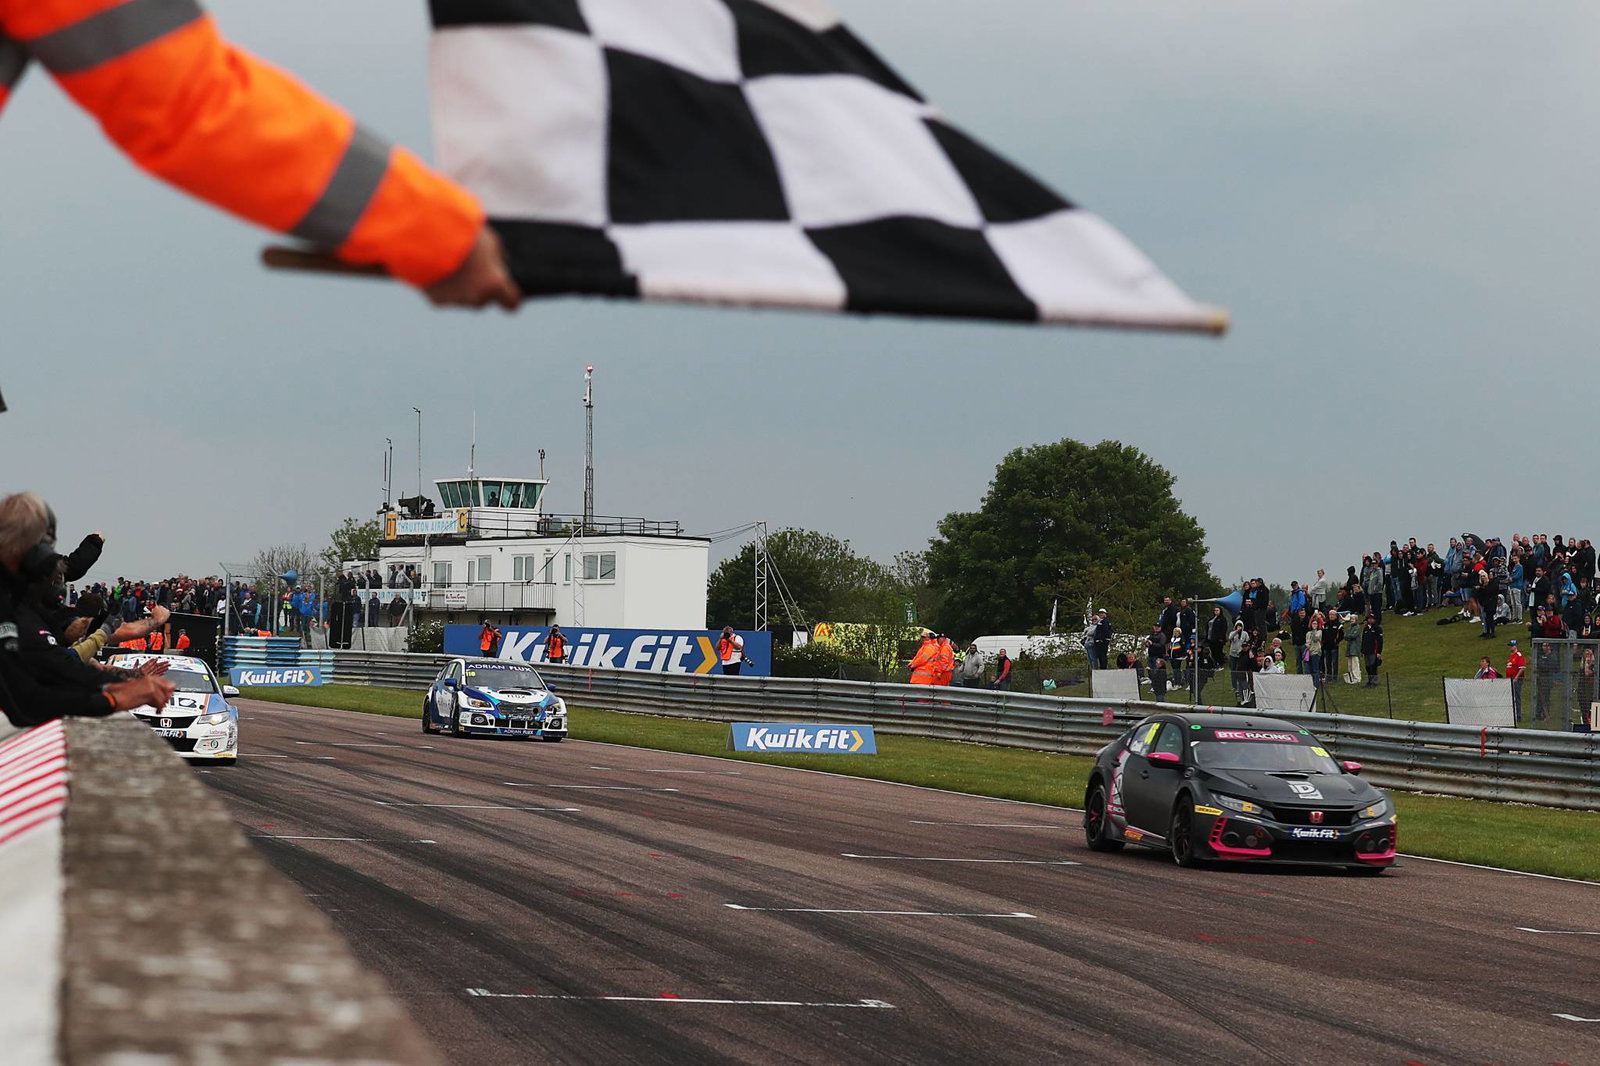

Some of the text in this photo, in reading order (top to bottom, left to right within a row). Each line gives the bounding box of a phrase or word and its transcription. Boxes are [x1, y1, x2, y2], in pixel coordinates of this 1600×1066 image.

[398, 520, 456, 533] THRUXTON AIRPORT
[1246, 732, 1291, 740] RACING
